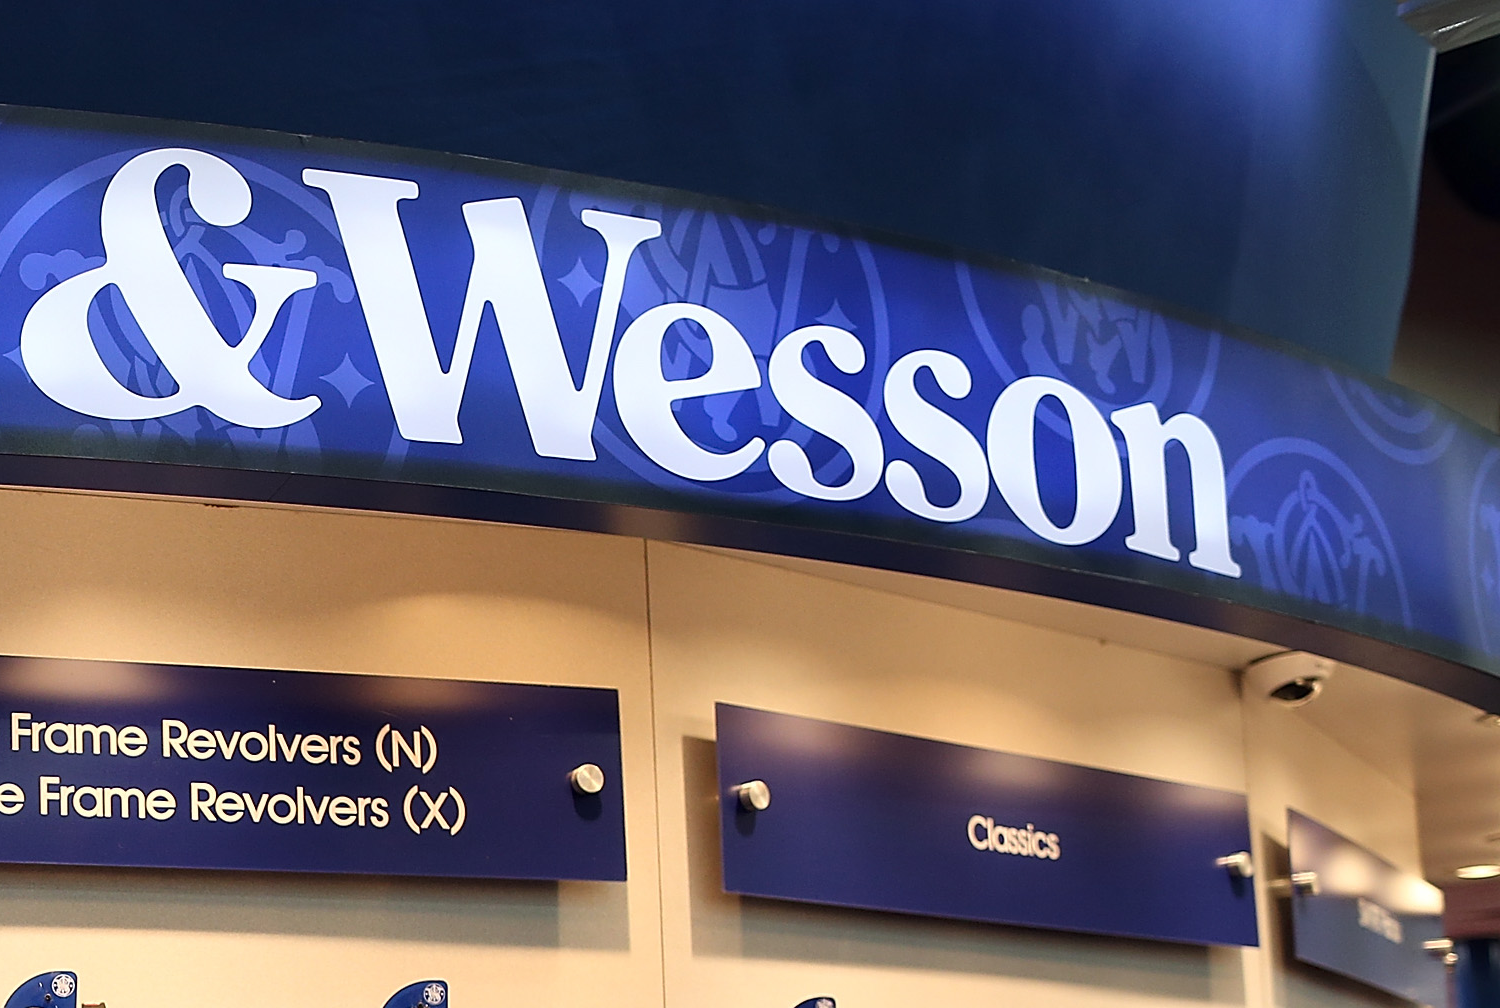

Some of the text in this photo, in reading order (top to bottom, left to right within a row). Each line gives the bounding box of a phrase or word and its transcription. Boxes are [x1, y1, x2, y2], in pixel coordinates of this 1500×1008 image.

[302, 168, 1242, 578] Wesson
[11, 712, 148, 757] Frame
[162, 719, 361, 766] Revolvers
[375, 723, 438, 775] (N)
[39, 775, 177, 821] Frame
[190, 782, 389, 828] Revolvers
[403, 784, 466, 836] (X)
[967, 815, 1061, 861] Classics
